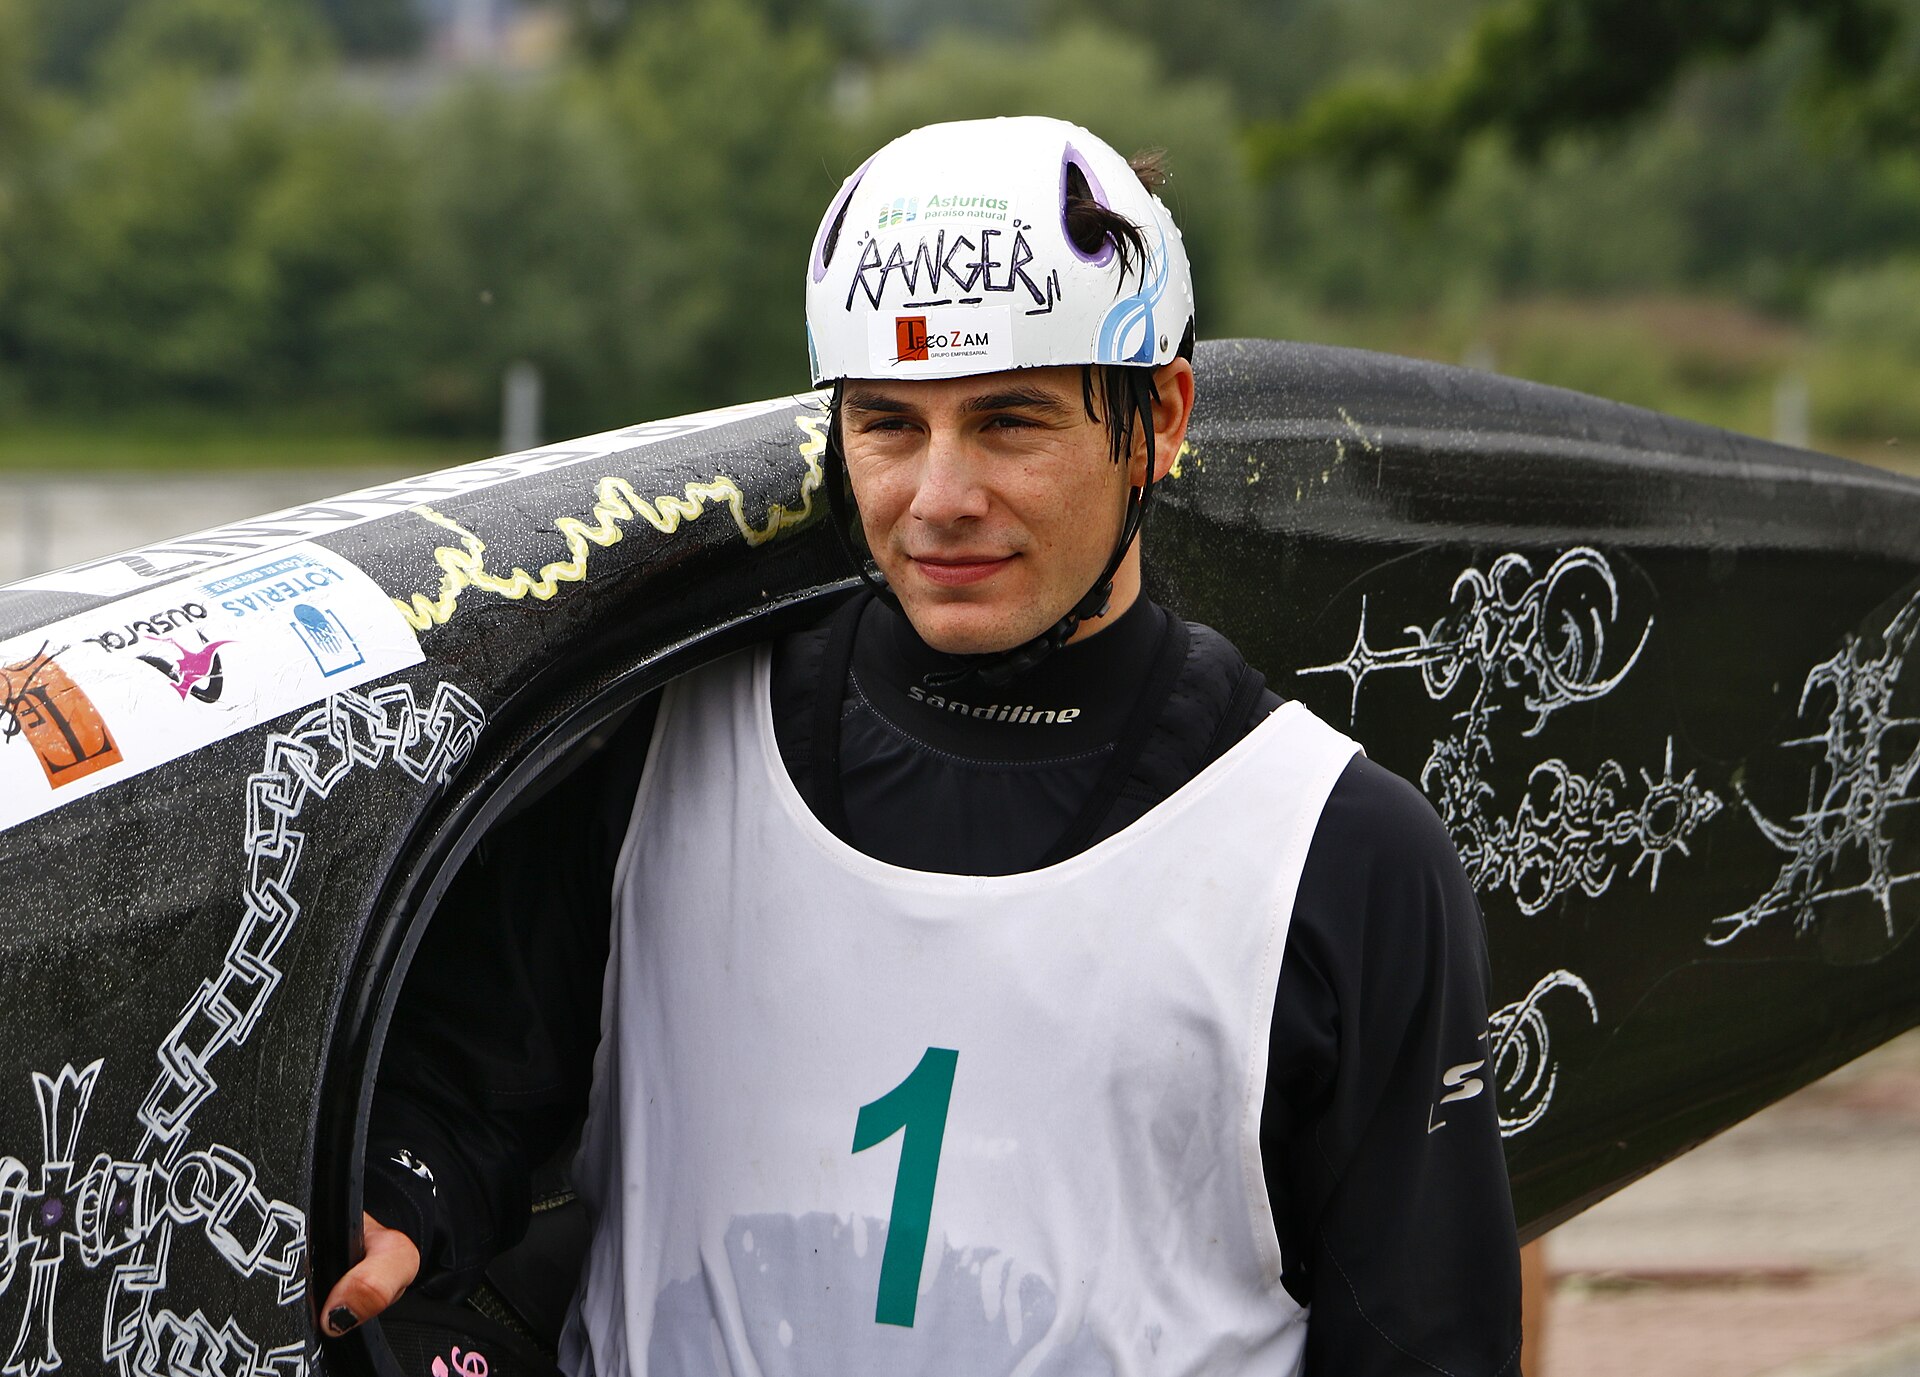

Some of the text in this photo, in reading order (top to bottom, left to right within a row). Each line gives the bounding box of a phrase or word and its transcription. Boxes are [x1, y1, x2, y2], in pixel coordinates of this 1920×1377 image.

[924, 208, 1007, 221] paraíso natural
[926, 194, 1008, 211] Asturias
[846, 229, 1047, 311] RANGER
[907, 686, 1081, 724] sandiline
[851, 1046, 960, 1328] 1
